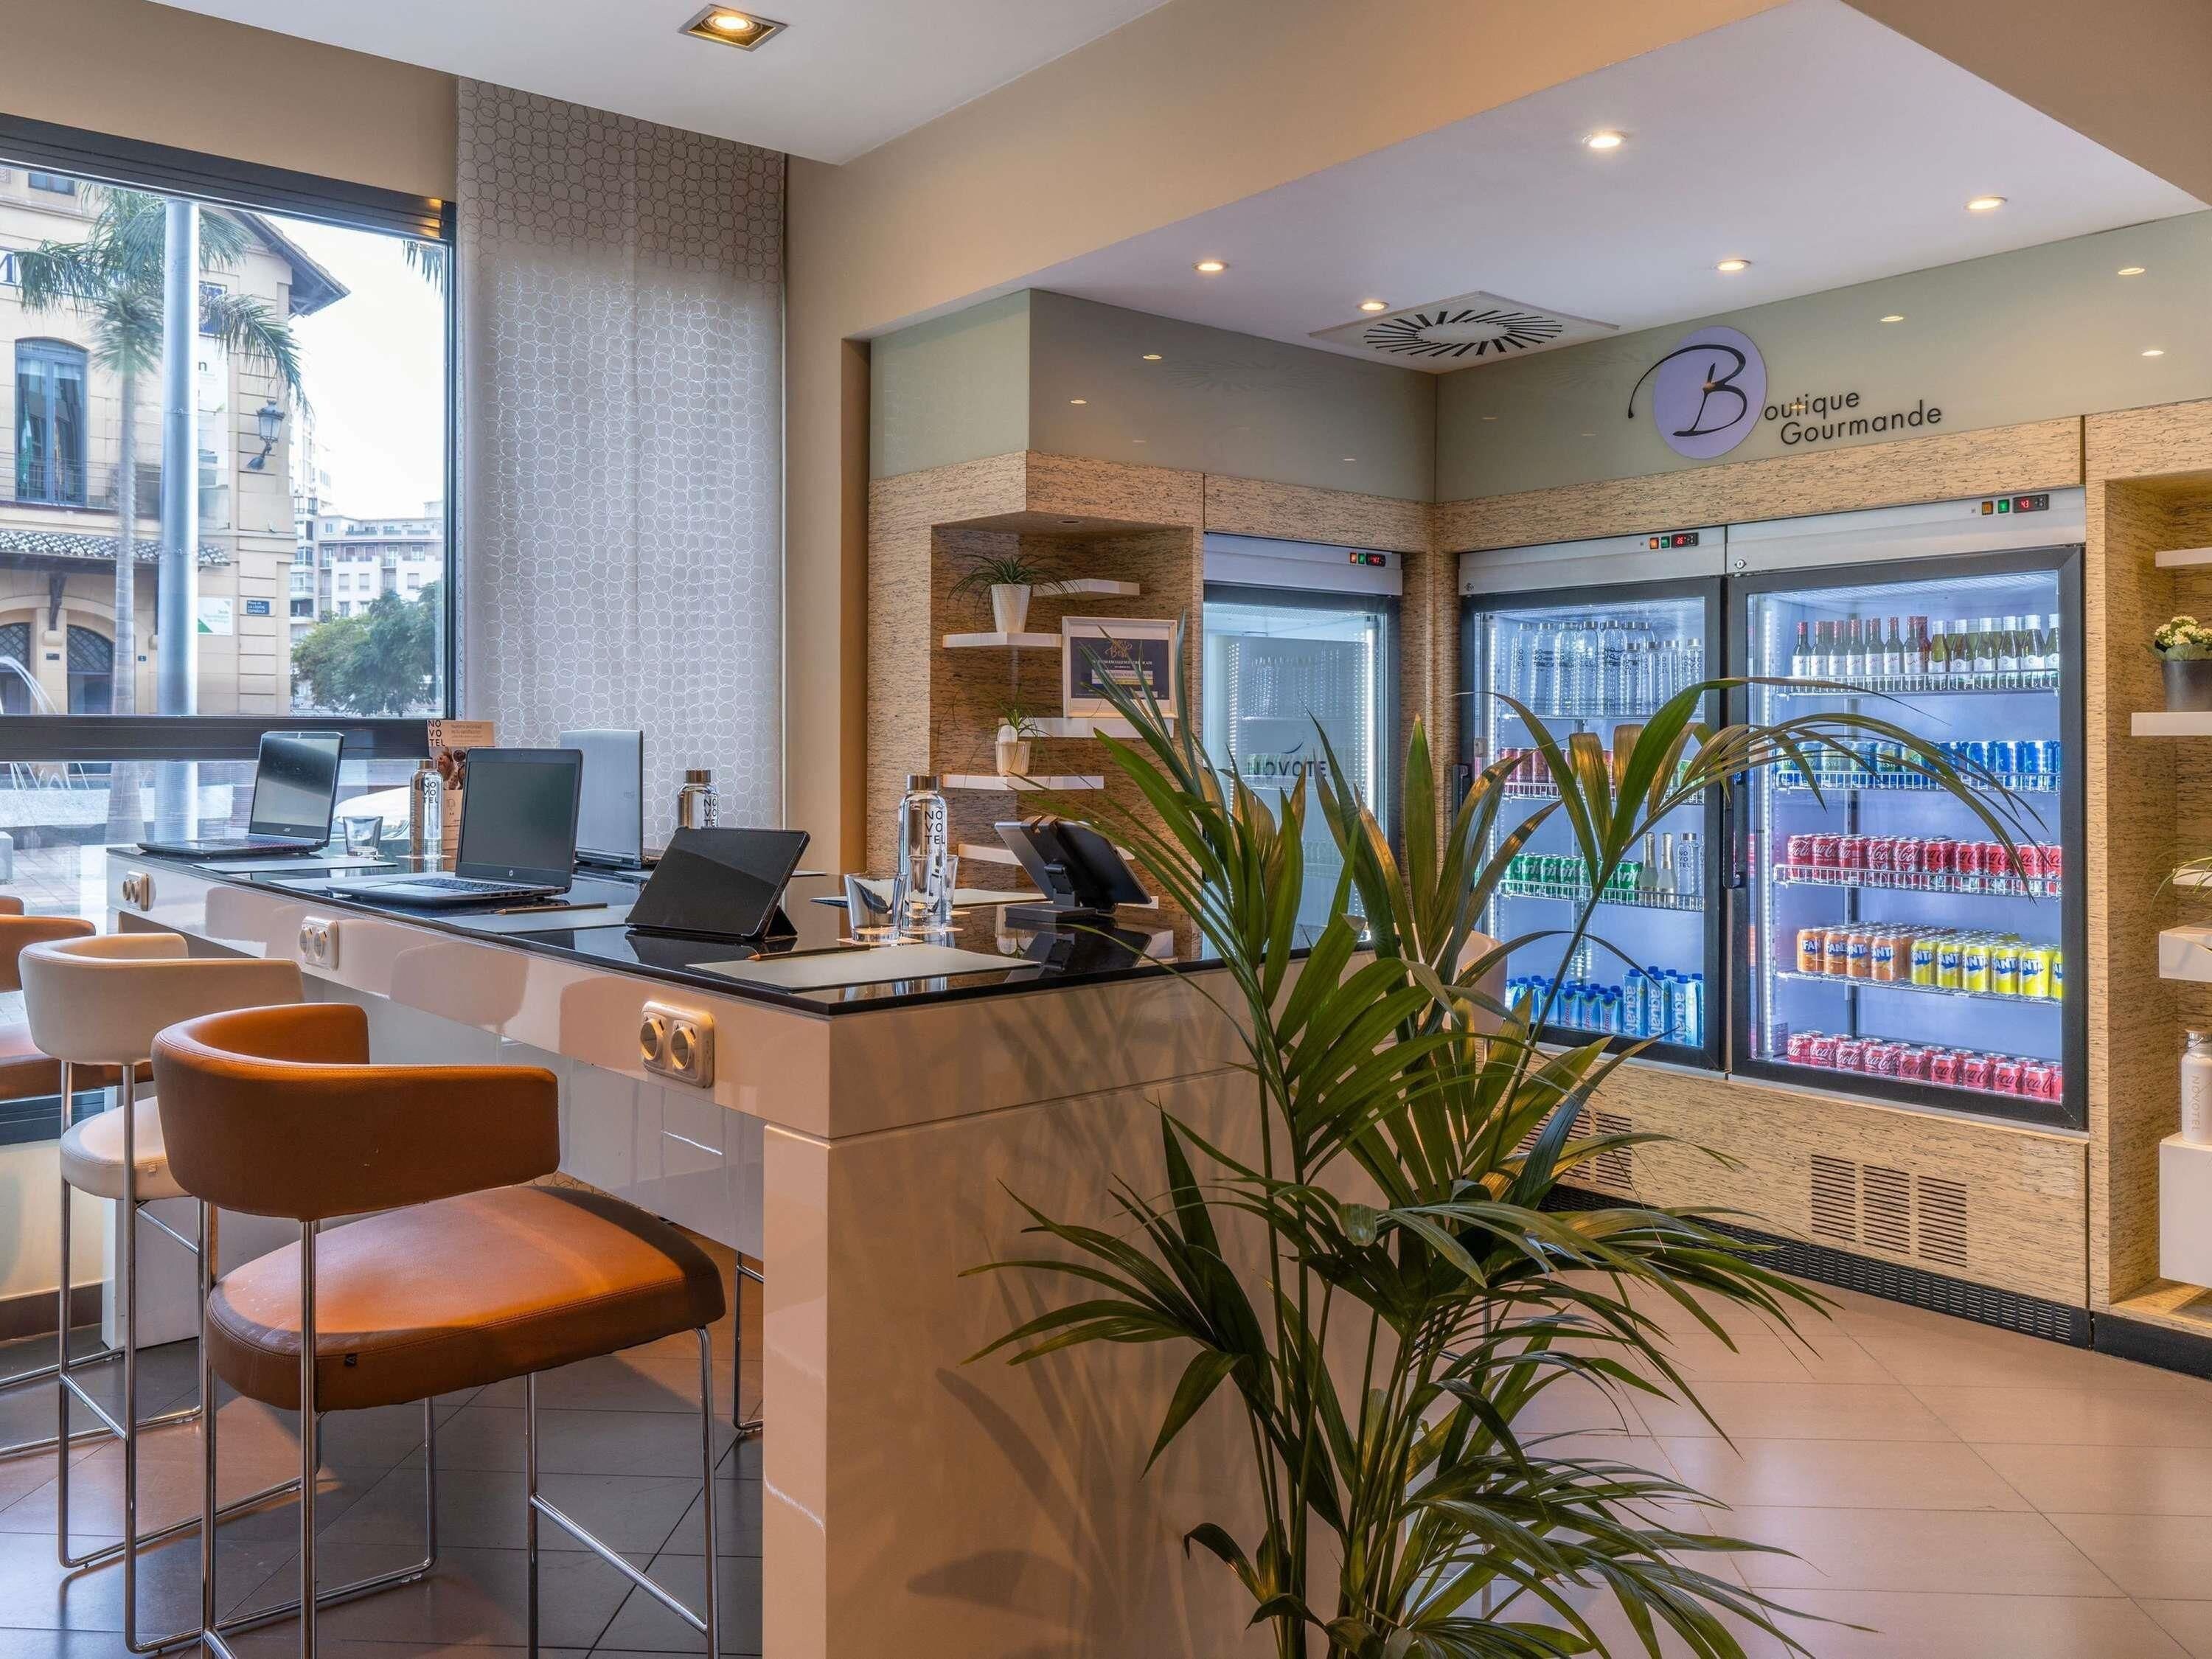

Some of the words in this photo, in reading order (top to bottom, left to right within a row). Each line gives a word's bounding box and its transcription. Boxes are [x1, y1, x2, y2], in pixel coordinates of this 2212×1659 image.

[1781, 400, 1943, 445] Gourmande
[428, 720, 442, 728] NO
[429, 729, 442, 737] VO
[429, 738, 445, 747] TEL
[1247, 761, 1328, 777] NOVOTE
[924, 810, 943, 820] NO
[925, 823, 943, 832] VO
[925, 835, 946, 844] TEL
[1802, 940, 1821, 950] FAN
[2191, 1074, 2201, 1132] NOVOTEL
